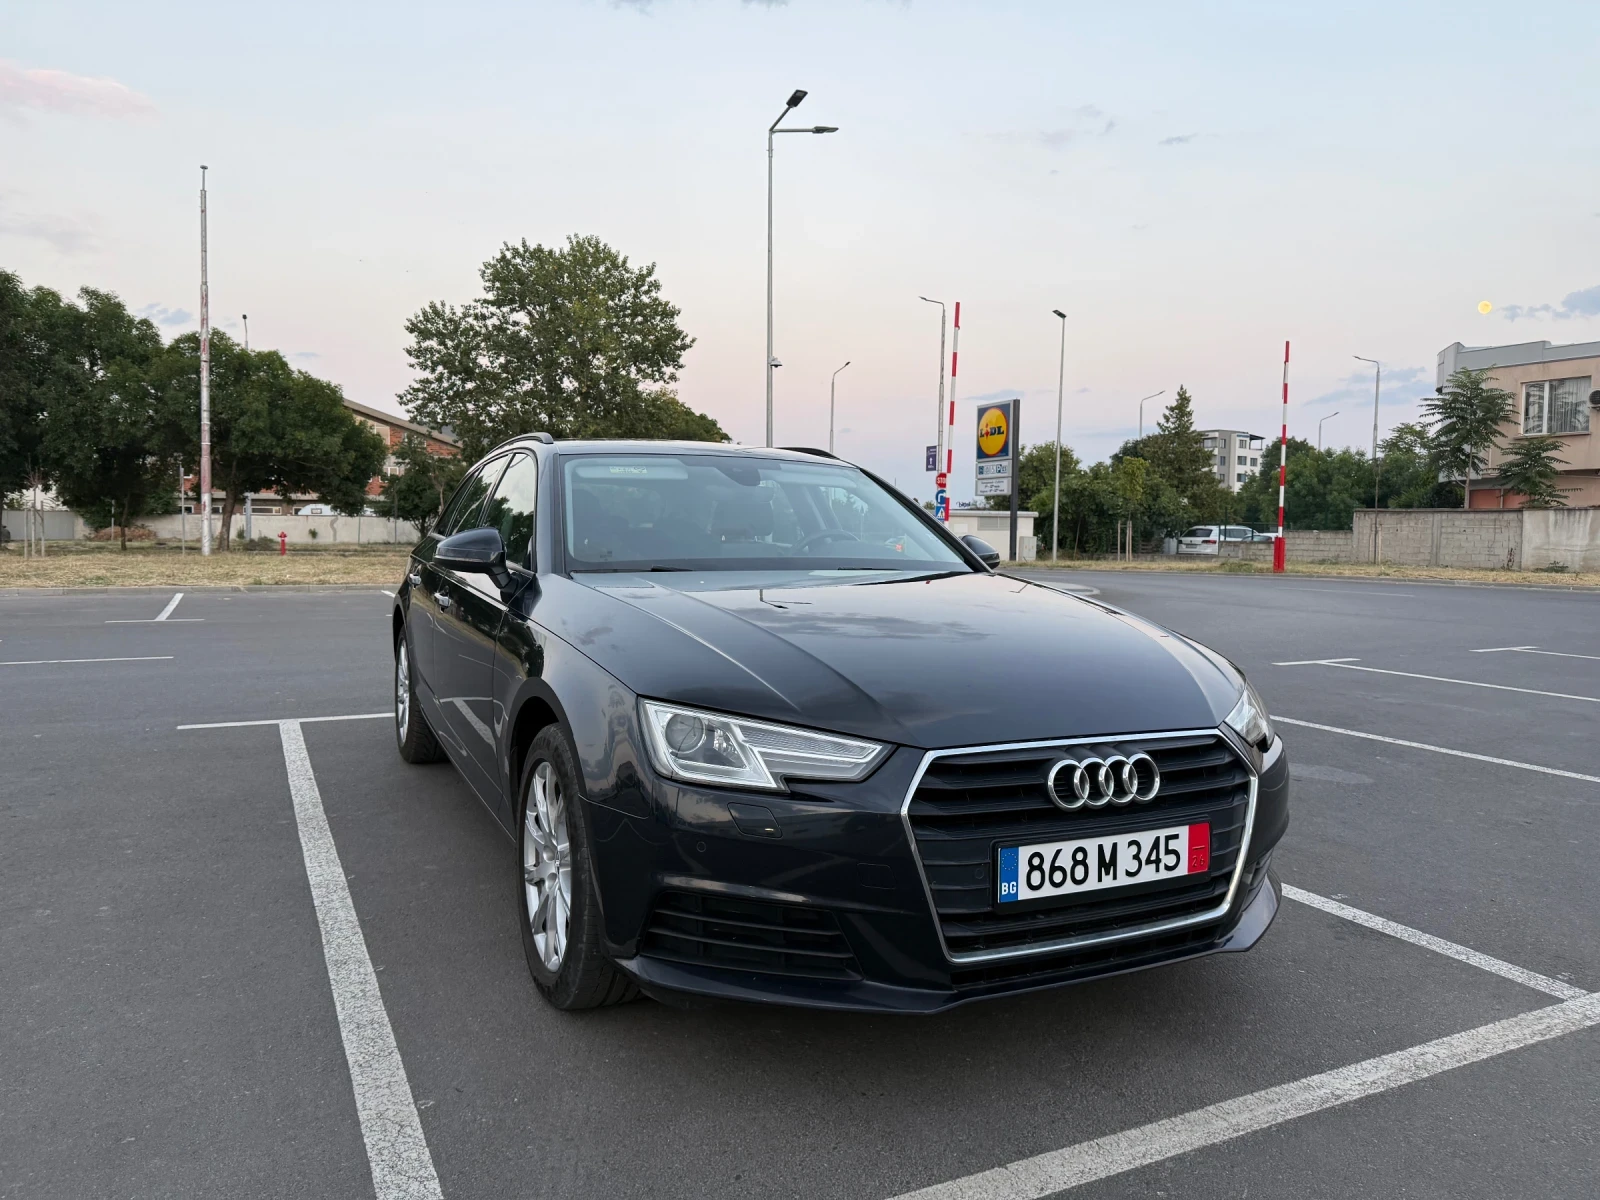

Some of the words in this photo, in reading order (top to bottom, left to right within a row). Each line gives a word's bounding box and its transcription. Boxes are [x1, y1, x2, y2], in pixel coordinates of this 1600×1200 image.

[1026, 846, 1089, 891] 868
[1097, 842, 1118, 883] M
[1125, 833, 1181, 877] 345
[1001, 882, 1017, 896] BG
